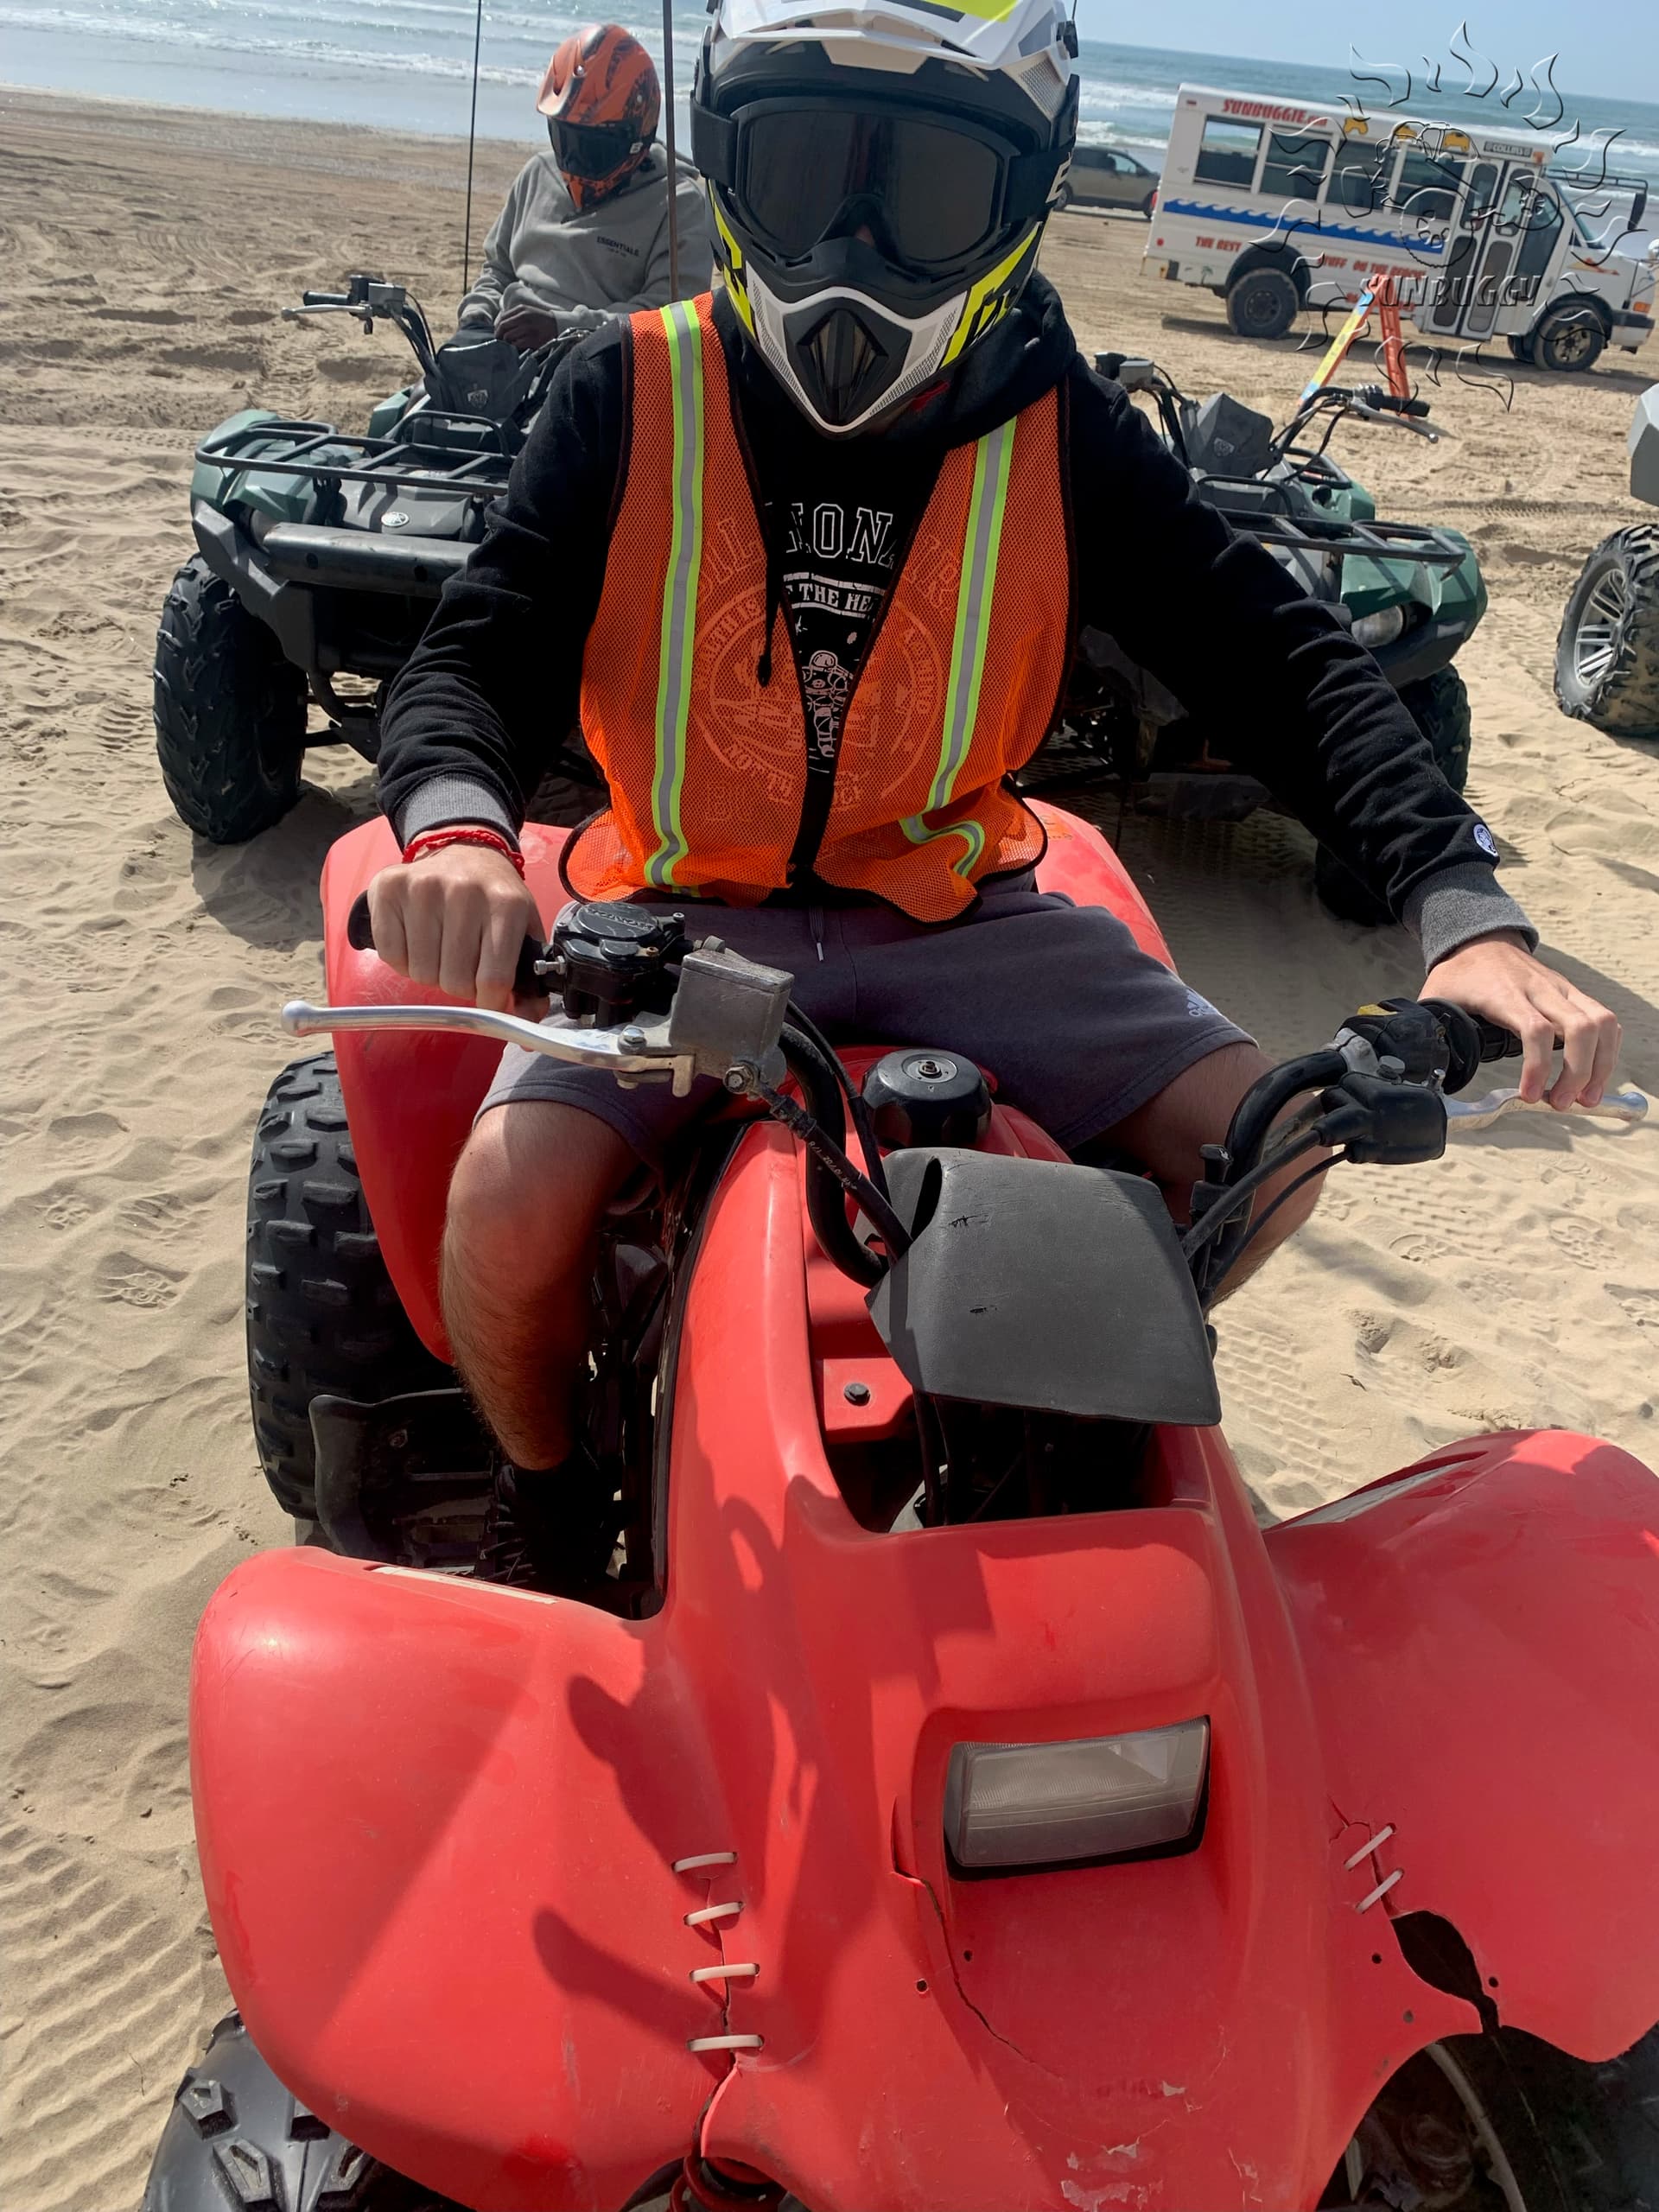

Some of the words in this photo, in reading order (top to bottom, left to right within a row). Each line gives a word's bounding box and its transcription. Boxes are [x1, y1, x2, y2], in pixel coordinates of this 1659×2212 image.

[597, 235, 639, 257] ESSENTIALS
[1196, 236, 1215, 249] THE
[1216, 239, 1243, 252] BEST
[798, 582, 840, 608] THE
